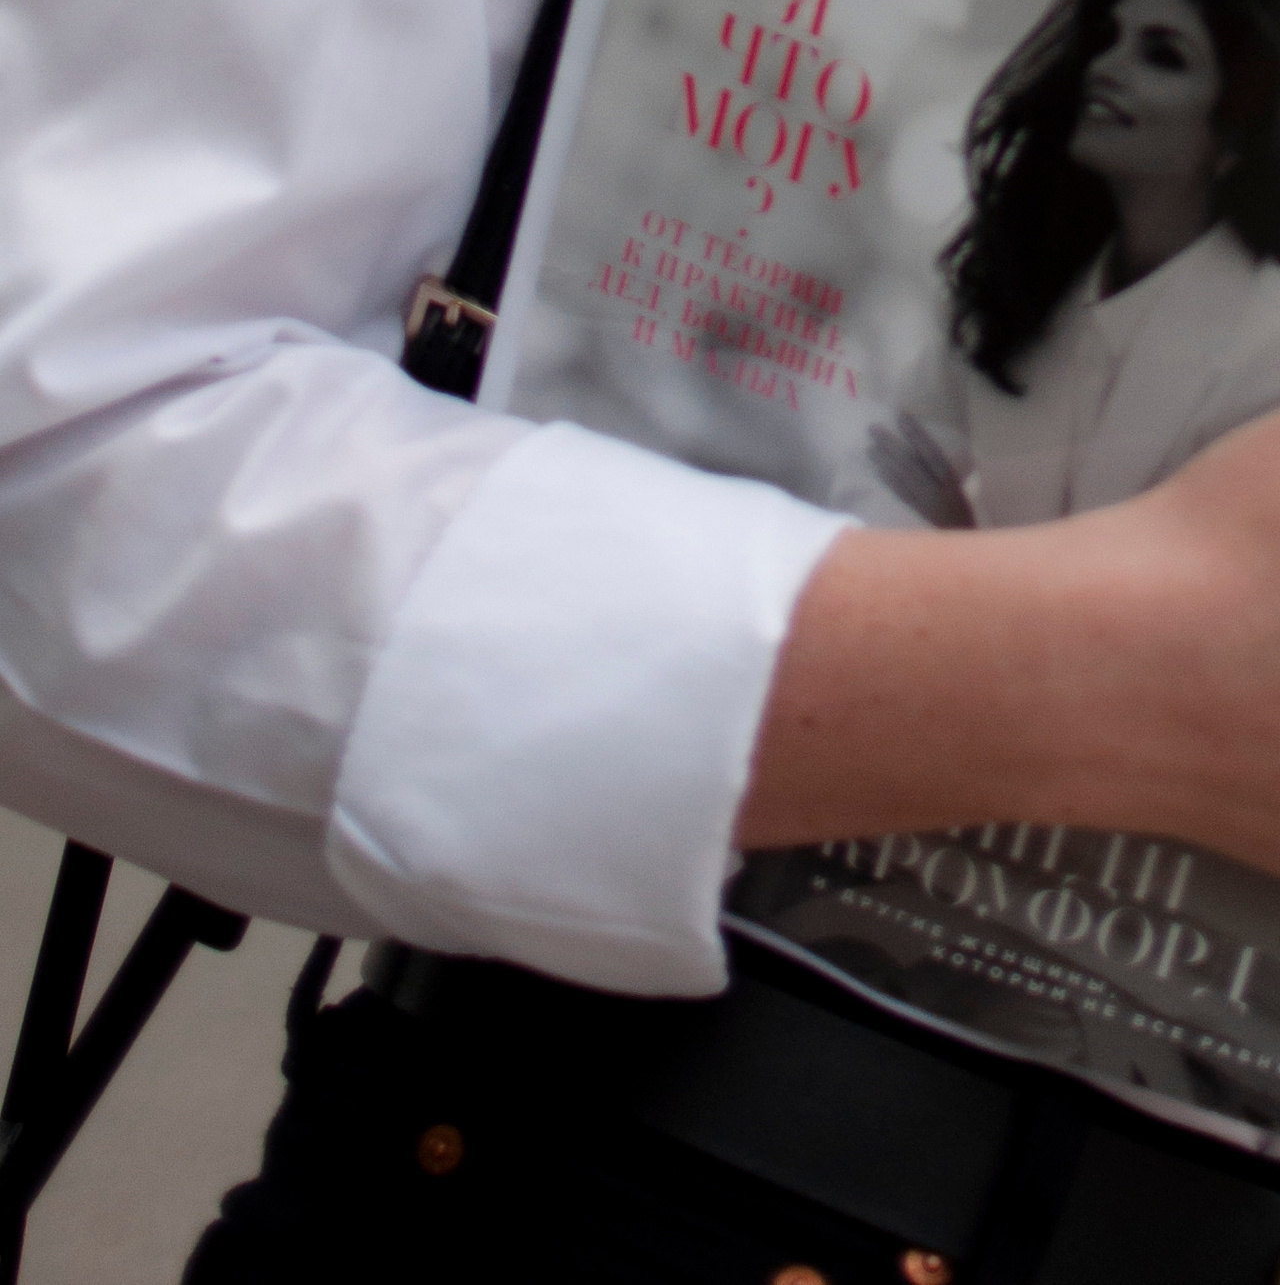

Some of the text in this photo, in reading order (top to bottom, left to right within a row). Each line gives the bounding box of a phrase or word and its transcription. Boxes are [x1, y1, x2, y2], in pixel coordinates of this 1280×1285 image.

[719, 11, 873, 128] ЧТО
[670, 71, 882, 199] МОГУ
[623, 237, 848, 358] К ПРАКТИКЕ
[641, 209, 843, 317] ОТ ТЕОРИИ
[633, 315, 799, 410] И МАЛЫХ
[681, 298, 860, 398] БОЛЬШИХ
[840, 887, 943, 938] ДРУГИЕ
[931, 944, 1067, 1001] КОТОРЫМ
[1082, 997, 1116, 1018] НЕ
[1131, 1013, 1184, 1041] ВСЕ
